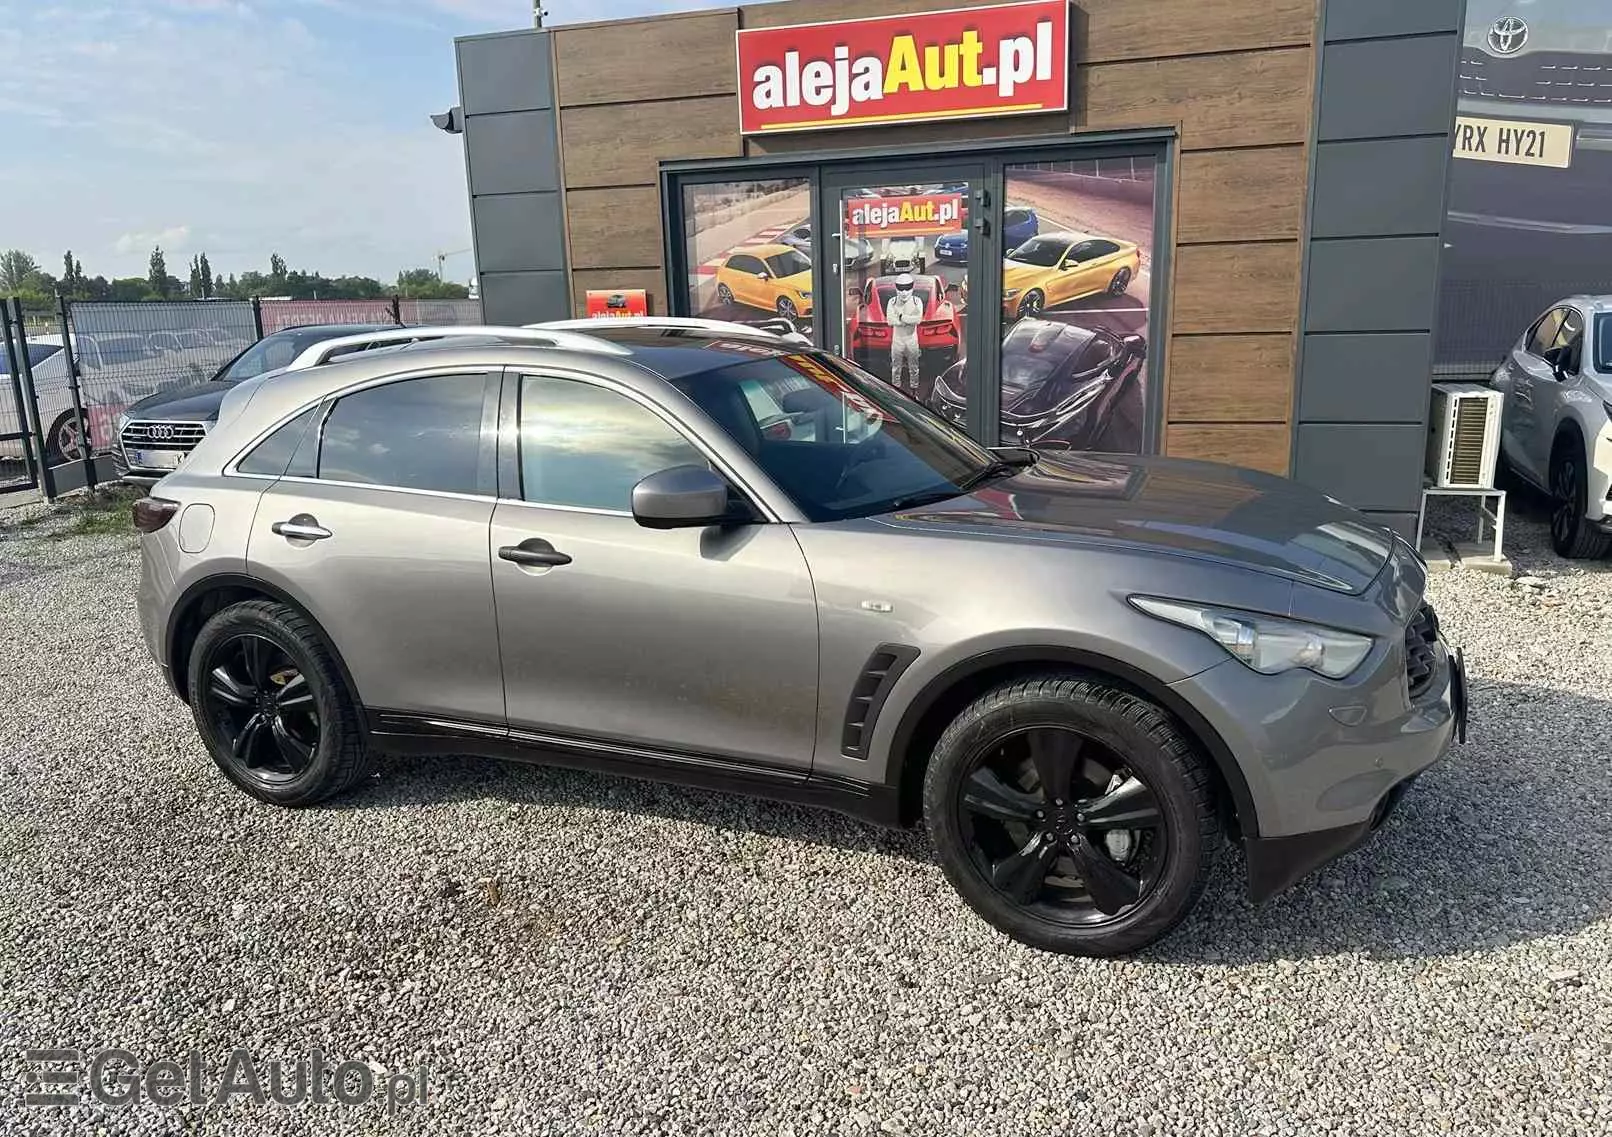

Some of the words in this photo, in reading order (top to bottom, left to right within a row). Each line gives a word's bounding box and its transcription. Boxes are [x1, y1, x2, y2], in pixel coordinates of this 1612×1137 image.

[752, 21, 1053, 116] alejaAut.pl
[1497, 127, 1546, 158] HY21
[851, 199, 958, 228] alejaAut.pl
[591, 310, 644, 319] alejaAutpl
